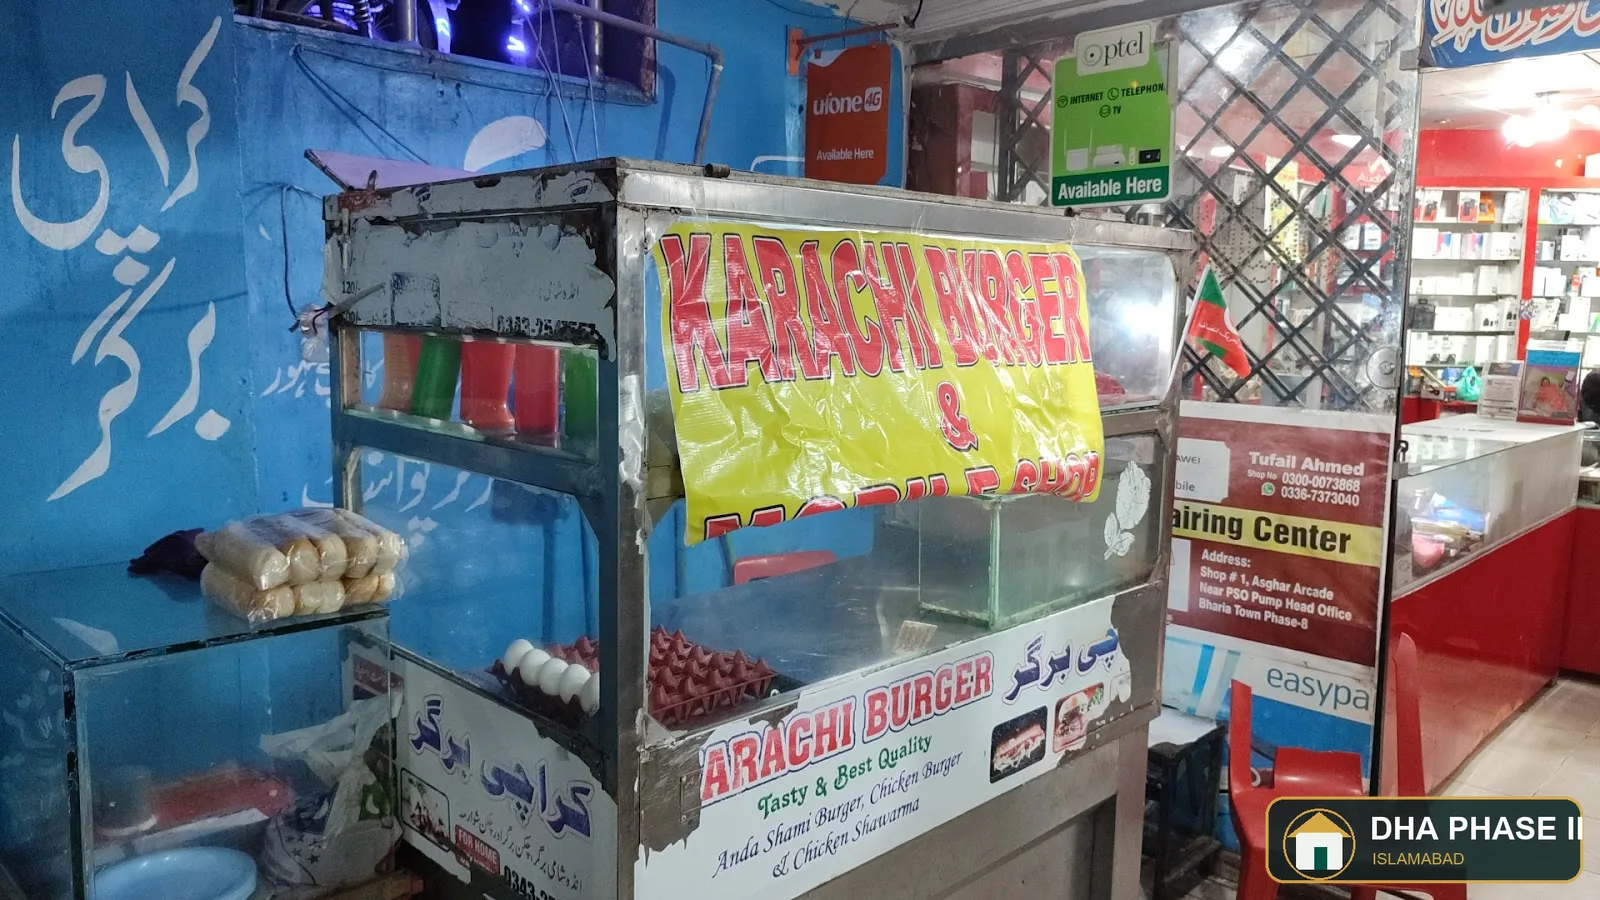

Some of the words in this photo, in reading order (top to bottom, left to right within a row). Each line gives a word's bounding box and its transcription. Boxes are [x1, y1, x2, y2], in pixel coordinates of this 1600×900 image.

[1103, 31, 1144, 66] ptcl
[813, 93, 863, 116] ufone
[865, 88, 881, 111] 4G
[1069, 91, 1104, 105] INTERNET
[1112, 105, 1122, 115] TV
[816, 148, 853, 161] Available
[855, 147, 874, 160] Here
[1058, 180, 1121, 200] Available
[1125, 175, 1162, 195] Here
[659, 232, 942, 394] KARACHI
[922, 244, 1093, 368] BURGER
[937, 381, 978, 451] &
[1176, 454, 1201, 465] AWEI
[1249, 451, 1296, 469] Tufail
[1301, 457, 1364, 476] Ahmed
[1175, 480, 1196, 492] bile
[1247, 469, 1265, 480] Shop
[1267, 471, 1277, 480] No
[1282, 472, 1360, 493] 0300-0073868
[1281, 487, 1360, 507] 0336-7373040
[1171, 505, 1243, 541] airing
[1253, 516, 1351, 554] Center
[1201, 548, 1251, 568] Address:
[1200, 566, 1226, 584] Shop
[1229, 571, 1238, 582] #
[1252, 576, 1291, 594] Asghar
[1293, 582, 1334, 600] Arcade
[1199, 598, 1231, 614] Bharia
[1234, 604, 1261, 620] Town
[1263, 609, 1309, 630] Phase-8
[1200, 582, 1224, 597] Near
[1226, 586, 1249, 601] PSO
[1251, 591, 1282, 610] Pump
[1285, 598, 1315, 615] Head
[1317, 603, 1352, 621] Office
[701, 697, 856, 803] ARACHI
[864, 650, 995, 743] BURGER
[758, 784, 808, 820] Tasty
[815, 776, 828, 797] &
[834, 755, 872, 791] Best
[878, 735, 933, 771] Quality
[481, 760, 592, 838] کراچی
[712, 835, 759, 879] Anda
[763, 812, 811, 853] Shami
[814, 795, 865, 830] Burger,
[869, 768, 920, 805] Chicken
[922, 750, 963, 783] Burger
[458, 829, 473, 849] FOR
[474, 839, 498, 865] HOME
[772, 852, 790, 878] &
[793, 831, 849, 868] Chicken
[851, 798, 920, 838] Shawarma
